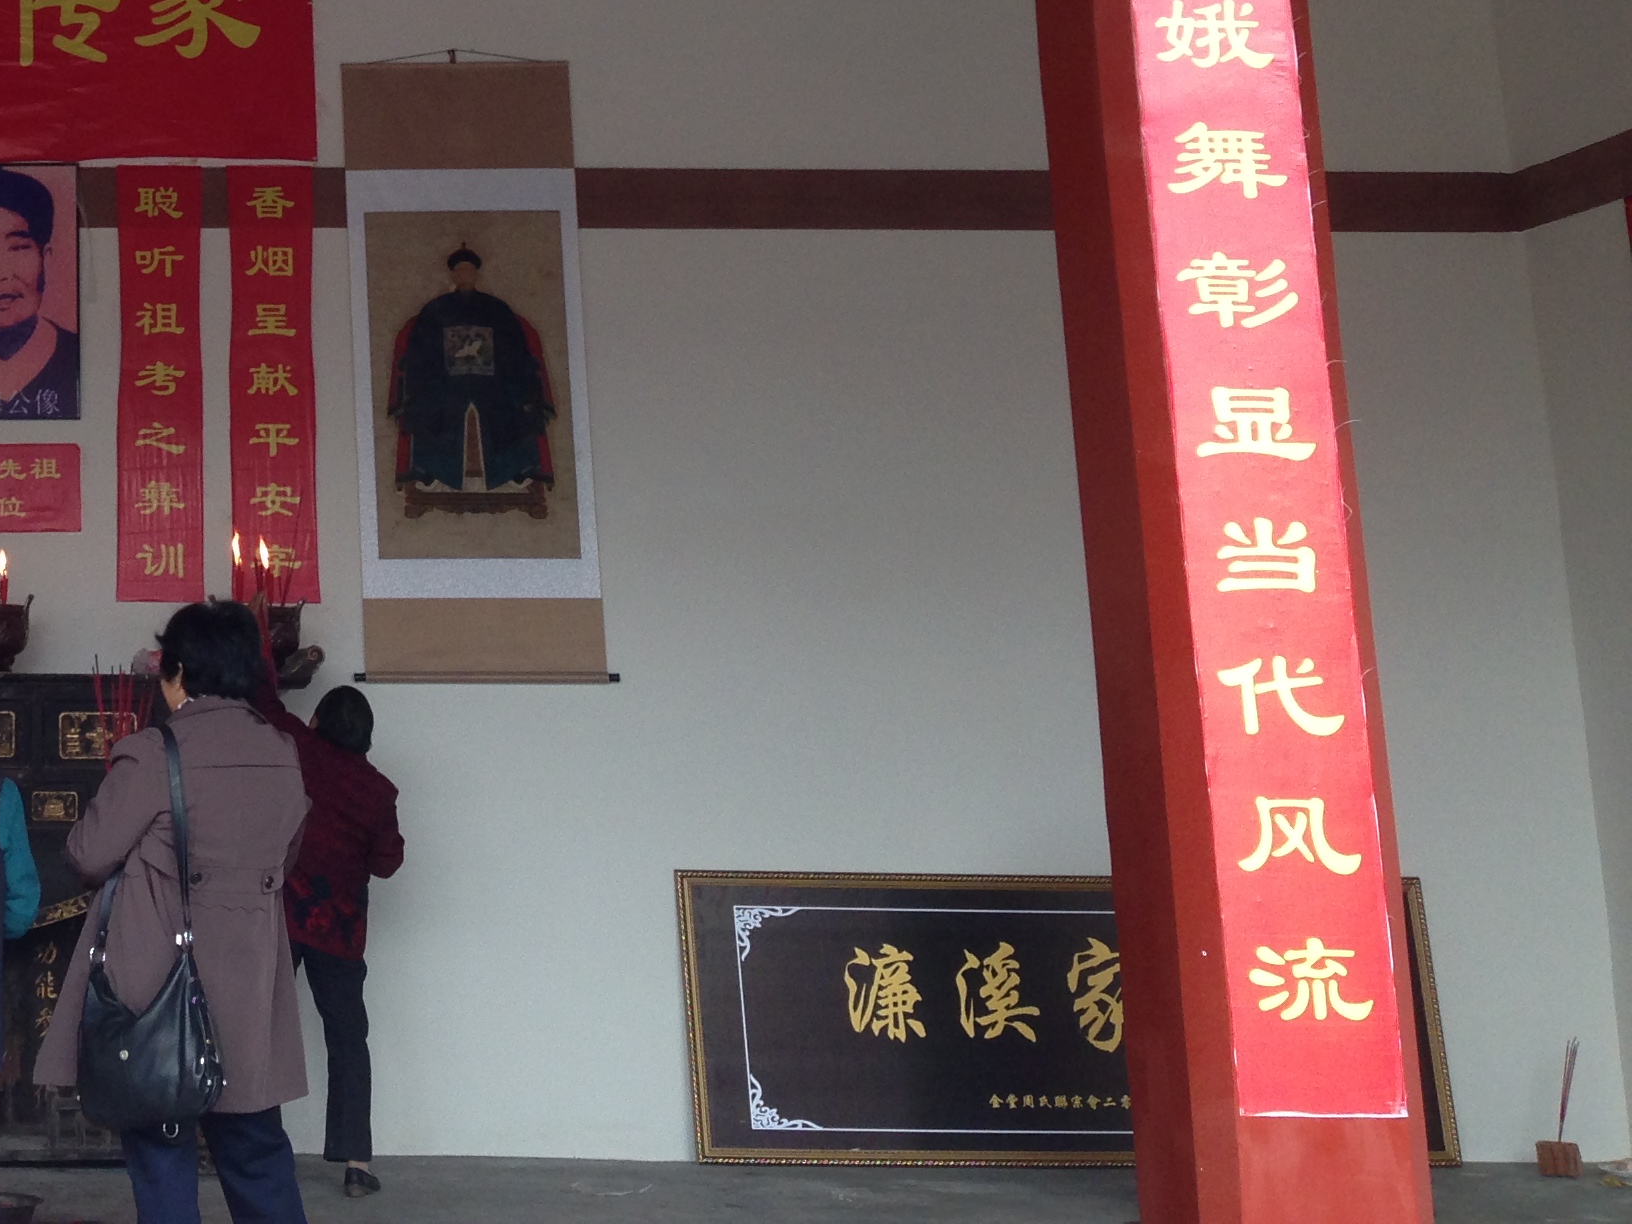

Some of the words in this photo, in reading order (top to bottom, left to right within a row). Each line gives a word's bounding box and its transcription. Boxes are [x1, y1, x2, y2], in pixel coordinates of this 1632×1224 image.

[245, 186, 302, 578] 香烟呈献平安字
